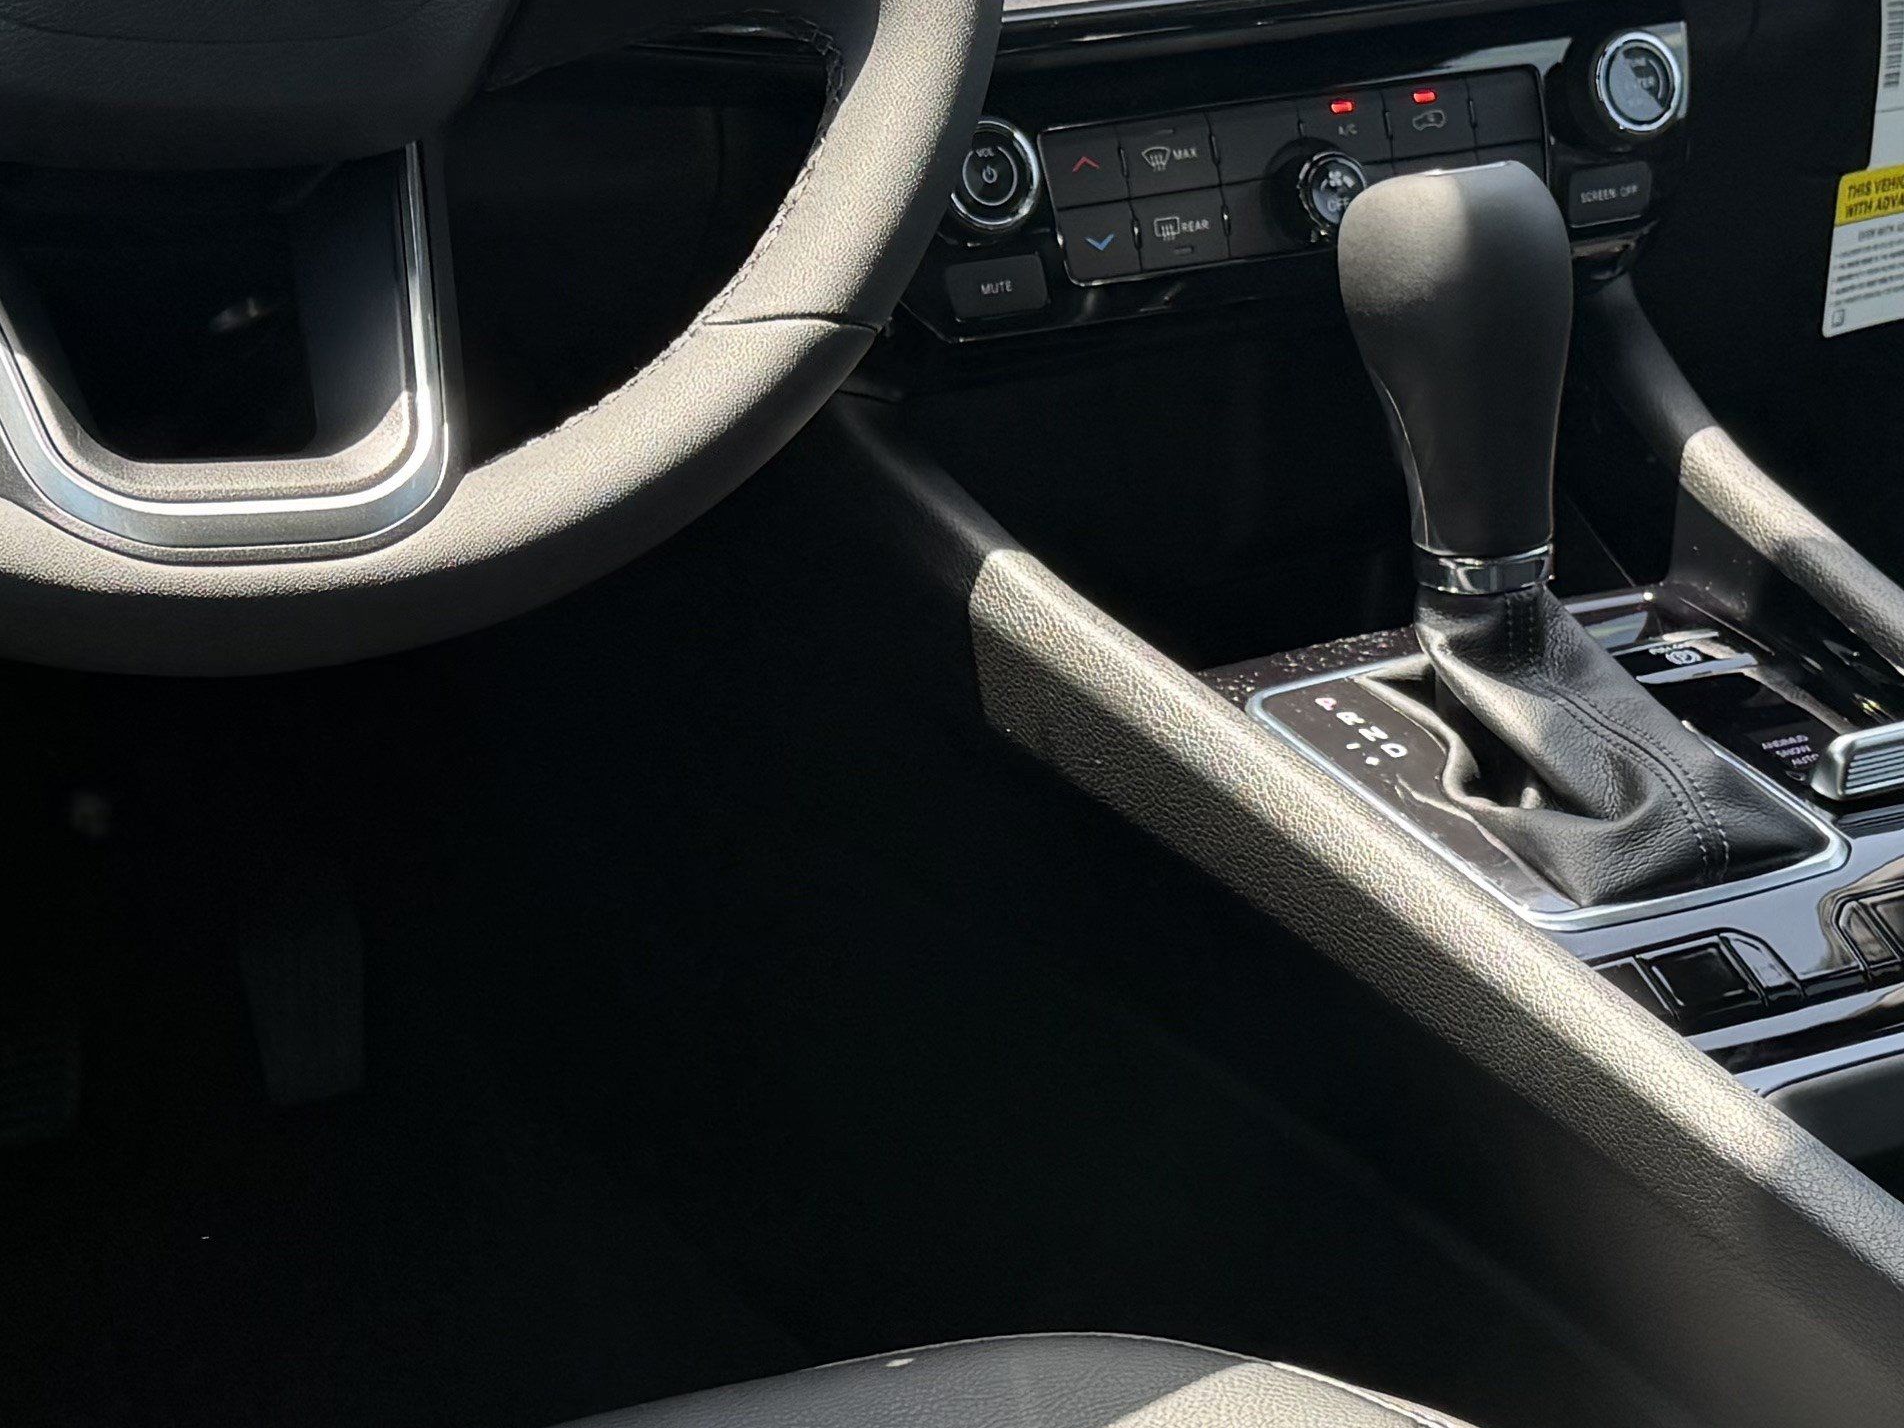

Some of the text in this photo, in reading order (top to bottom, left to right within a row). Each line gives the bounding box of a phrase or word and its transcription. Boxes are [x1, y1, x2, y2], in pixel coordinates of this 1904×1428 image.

[975, 146, 995, 159] VOL
[1172, 148, 1198, 161] MAX
[1580, 184, 1638, 204] SCREEN OFF
[1848, 182, 1872, 200] THIS
[1846, 199, 1873, 218] WITH
[1180, 219, 1211, 234] REAR
[980, 279, 1013, 295] MUTE
